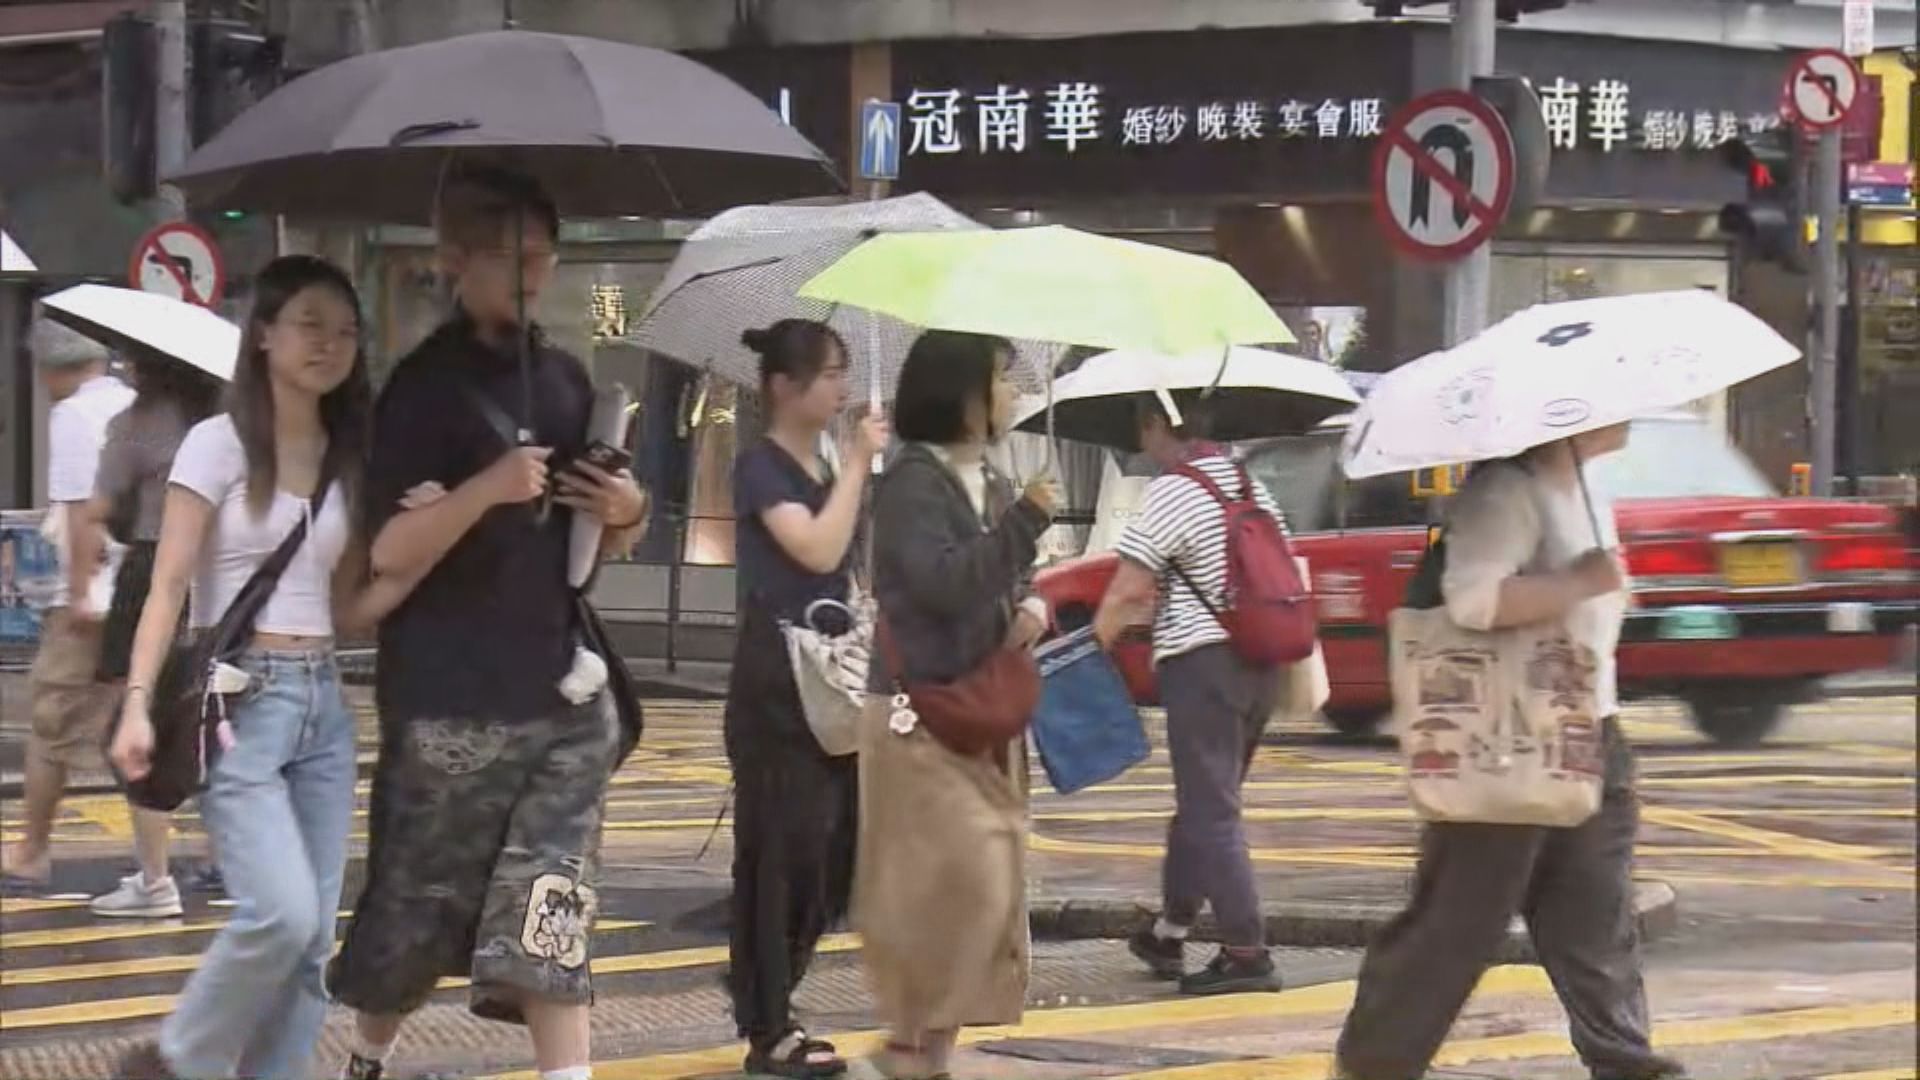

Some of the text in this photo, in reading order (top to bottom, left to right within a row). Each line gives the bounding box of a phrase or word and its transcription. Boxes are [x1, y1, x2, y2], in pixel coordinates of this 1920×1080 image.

[906, 82, 1382, 155] 冠南華 婚紗 晚裝 宴會服
[1521, 77, 1630, 152] 南華
